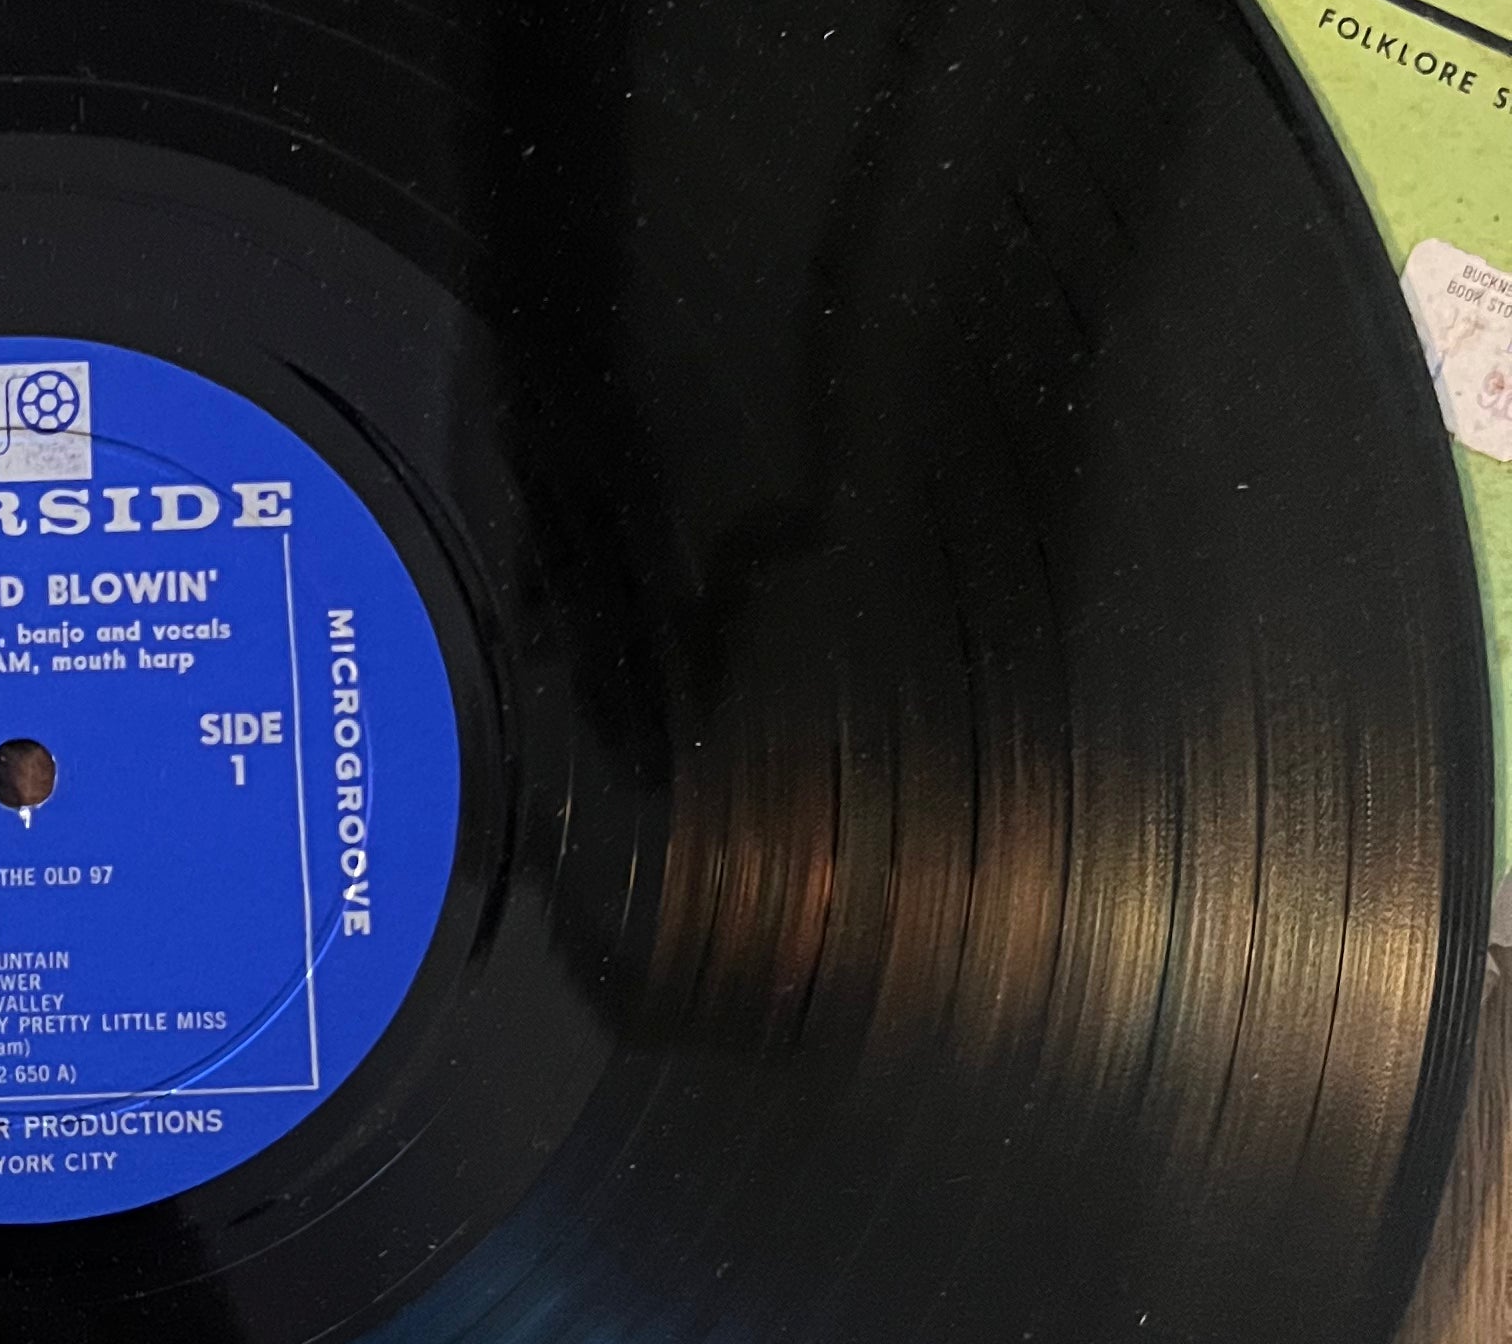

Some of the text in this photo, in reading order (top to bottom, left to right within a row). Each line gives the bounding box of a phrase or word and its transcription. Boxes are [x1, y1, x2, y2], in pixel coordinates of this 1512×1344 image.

[1318, 9, 1512, 115] FOLKLORE S
[1446, 280, 1485, 307] BOOK
[47, 569, 217, 606] BLOWIN'
[17, 621, 85, 649] banjo
[96, 620, 141, 642] and
[152, 617, 231, 641] vocals
[52, 648, 126, 672] mouth
[138, 647, 195, 674] harp
[199, 711, 283, 745] SIDE
[230, 754, 245, 786] 1
[327, 609, 372, 937] MICROGROOVE
[44, 866, 81, 885] OLD
[90, 865, 113, 884] 97
[19, 1014, 90, 1033] PRETTY
[102, 1012, 167, 1032] LITTLE
[177, 1011, 226, 1030] MISS
[57, 1064, 76, 1084] A)
[24, 1109, 223, 1139] PRODUCTIONS
[65, 1151, 117, 1172] CITY
